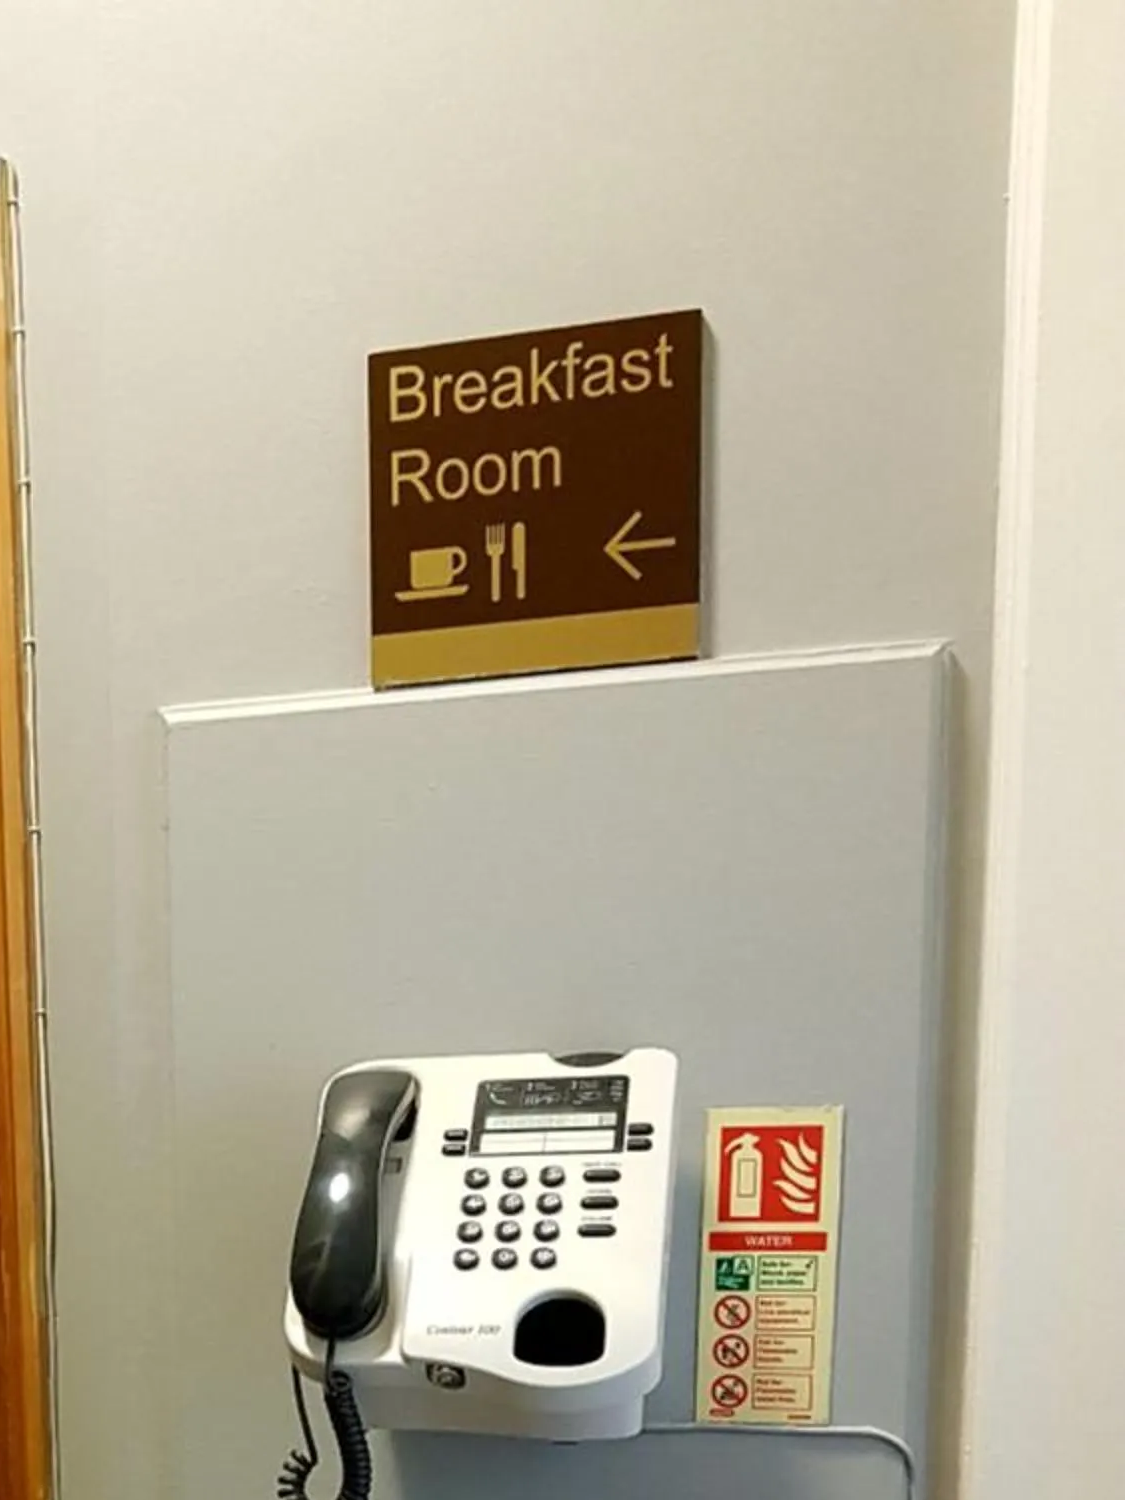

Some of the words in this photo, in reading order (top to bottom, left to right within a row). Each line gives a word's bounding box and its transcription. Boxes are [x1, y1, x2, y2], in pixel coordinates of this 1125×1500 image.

[389, 333, 674, 423] Breakfast
[391, 446, 562, 507] Room
[743, 1234, 793, 1247] WATER
